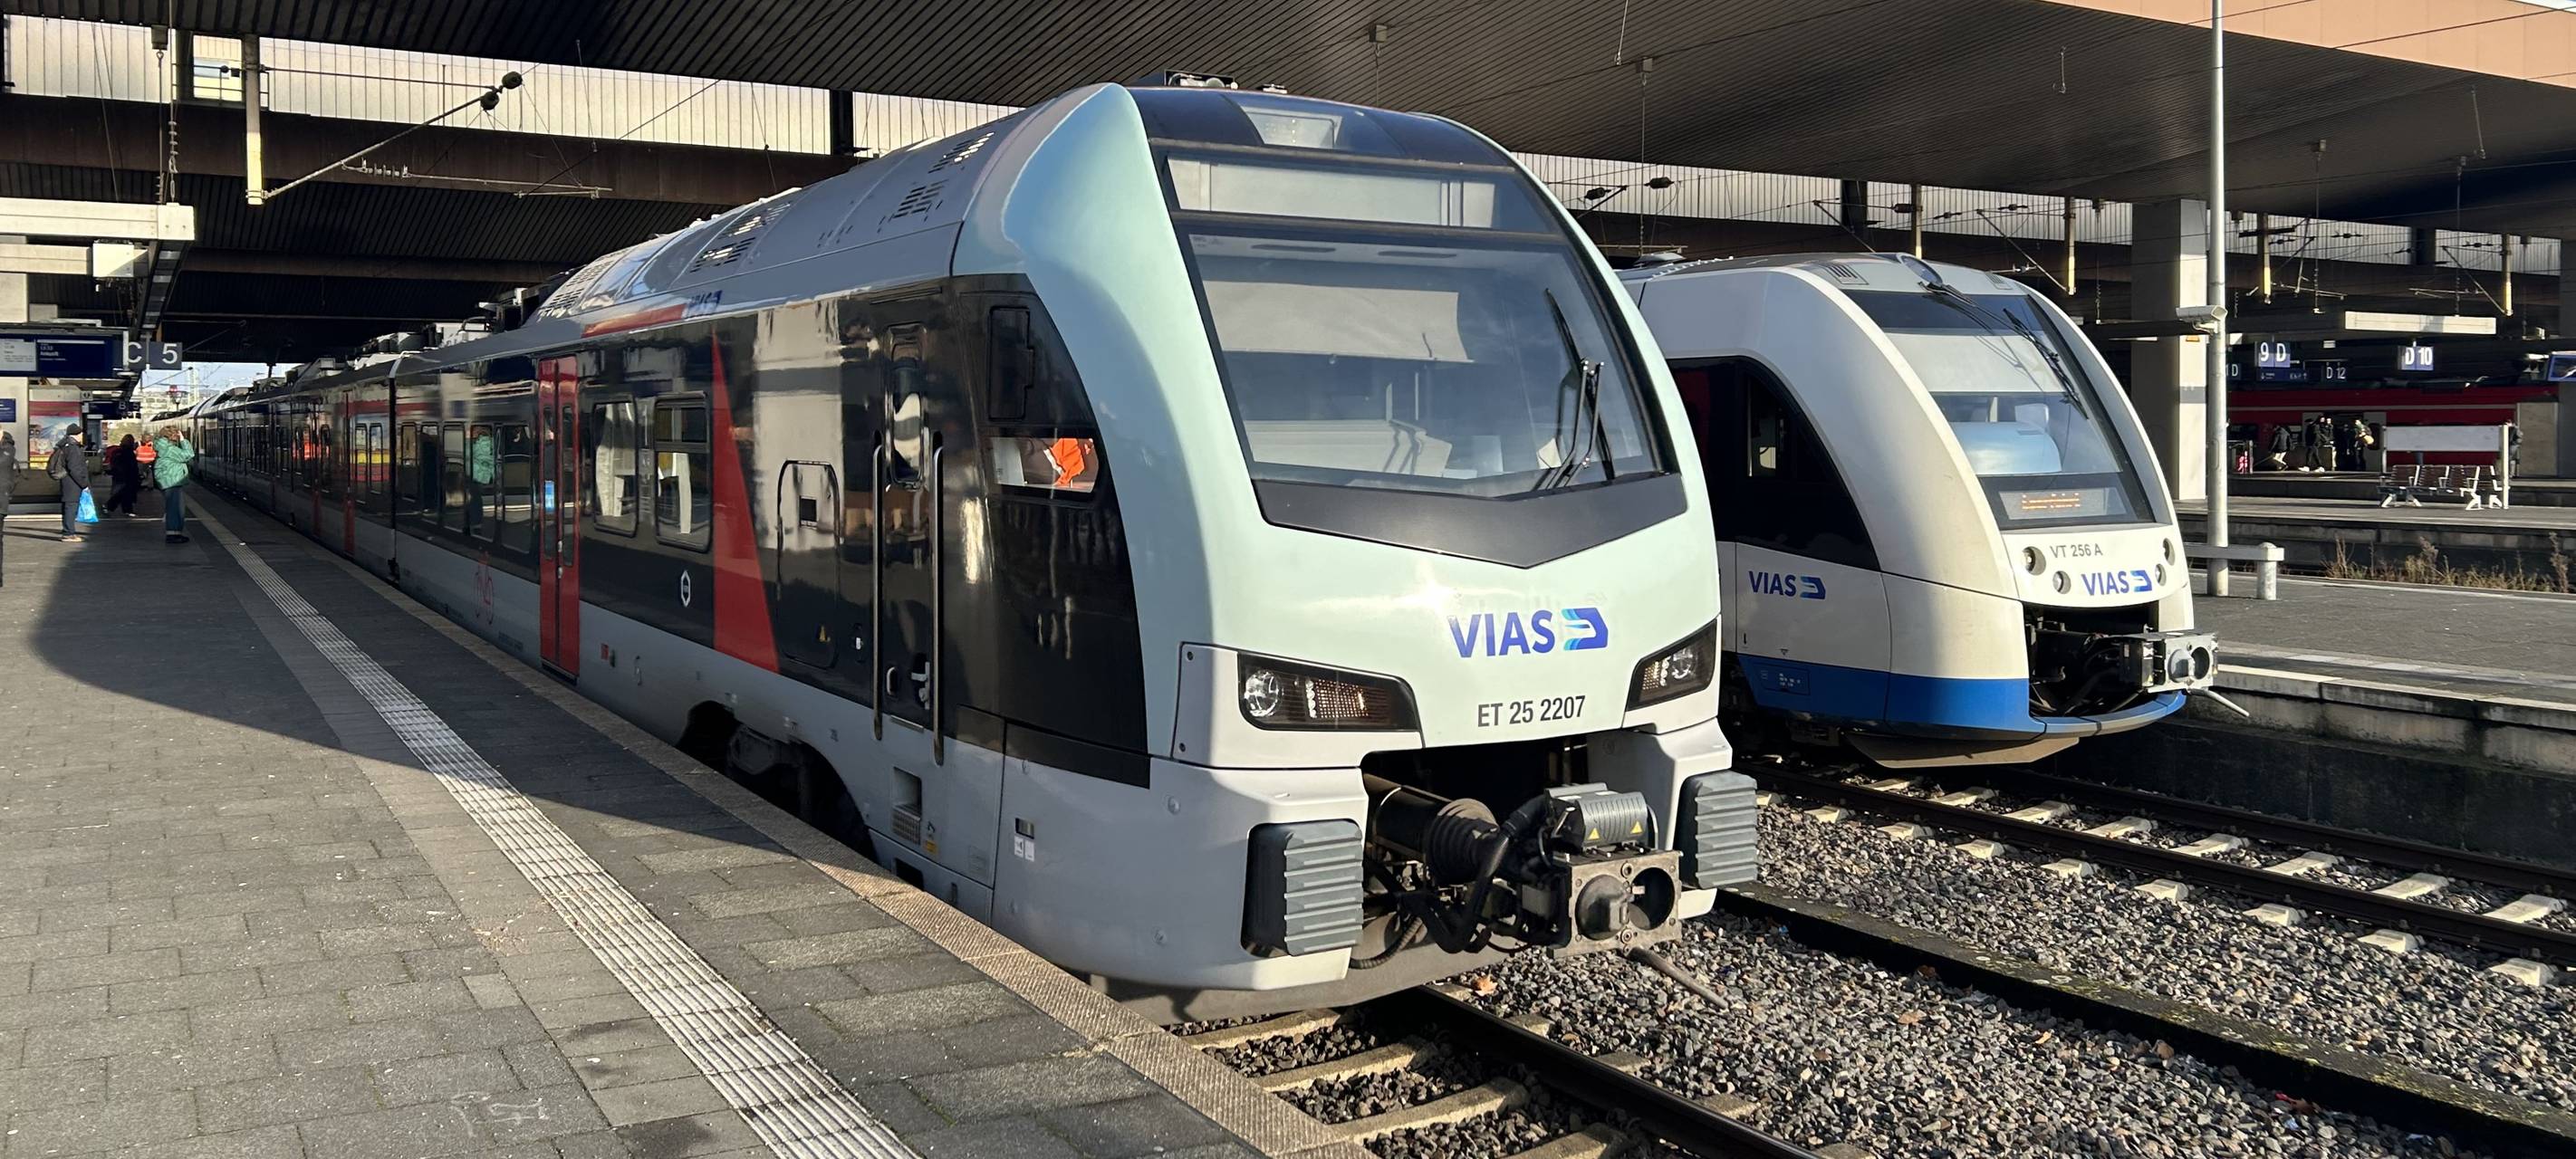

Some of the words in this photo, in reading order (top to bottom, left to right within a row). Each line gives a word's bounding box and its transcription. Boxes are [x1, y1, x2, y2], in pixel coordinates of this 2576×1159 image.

[128, 341, 142, 363] C
[162, 343, 178, 364] 5
[2261, 342, 2270, 362] 9
[2275, 343, 2287, 362] D
[2405, 348, 2415, 365] D
[2418, 349, 2433, 366] 10
[2231, 364, 2238, 377] D
[2326, 367, 2333, 379] D
[2336, 368, 2347, 379] 12
[2050, 545, 2068, 558] VT
[2071, 543, 2091, 557] 256
[2094, 543, 2103, 556] A
[1748, 570, 1797, 597] VIAS
[2081, 570, 2129, 596] VIAS
[1447, 609, 1555, 658] VIAS
[1477, 703, 1504, 727] ET
[1509, 700, 1533, 724] 25
[1540, 695, 1586, 722] 2207
